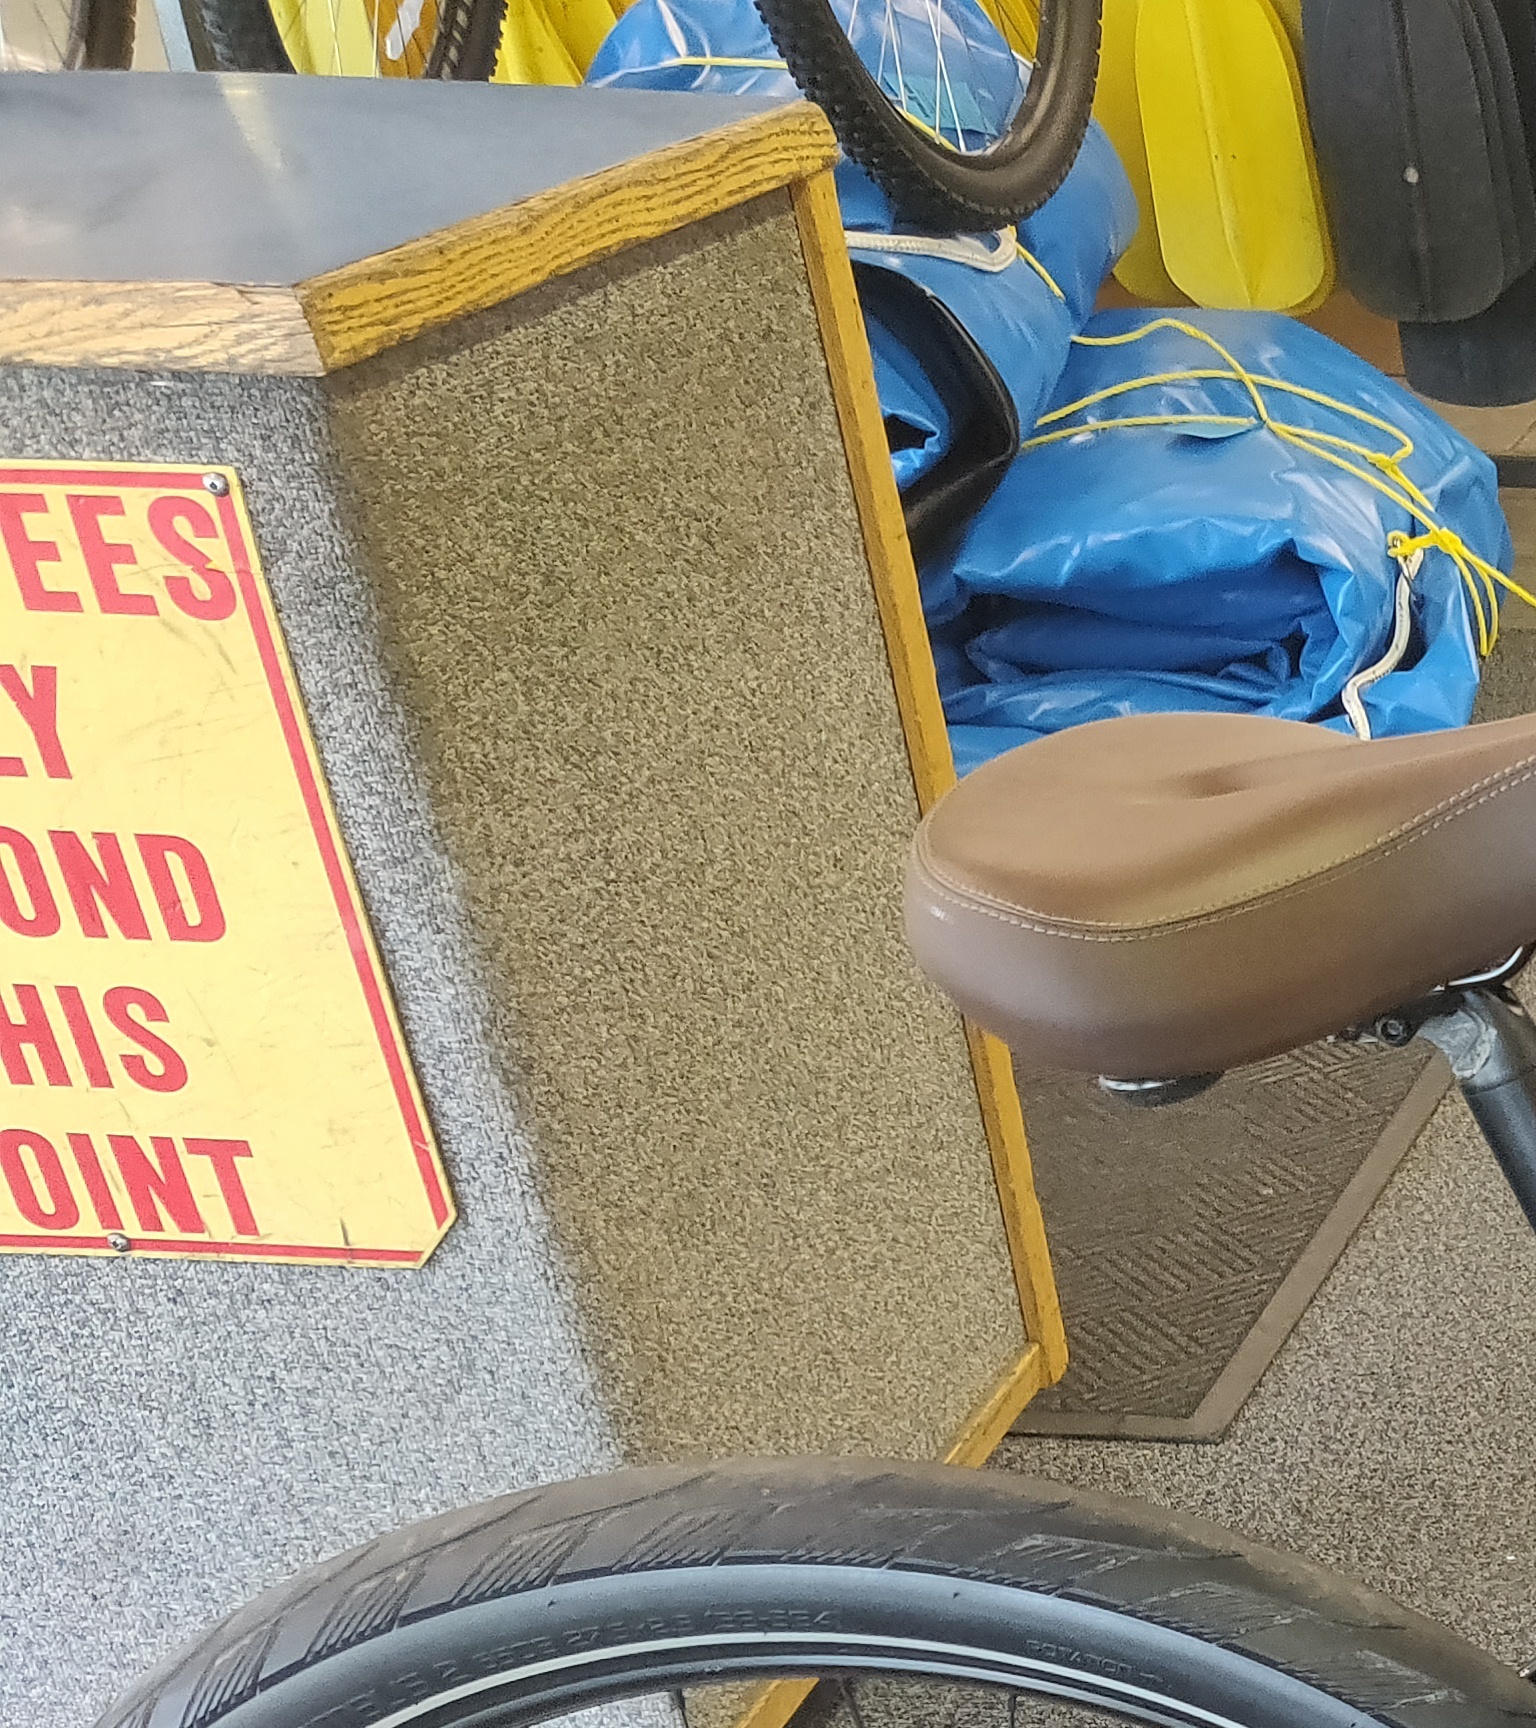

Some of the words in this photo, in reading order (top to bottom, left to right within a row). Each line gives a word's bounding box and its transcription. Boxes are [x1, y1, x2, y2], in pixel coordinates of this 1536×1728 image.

[0, 493, 237, 620] EES
[0, 826, 226, 942] OND
[0, 984, 188, 1092] HIS
[0, 1129, 260, 1236] OINT
